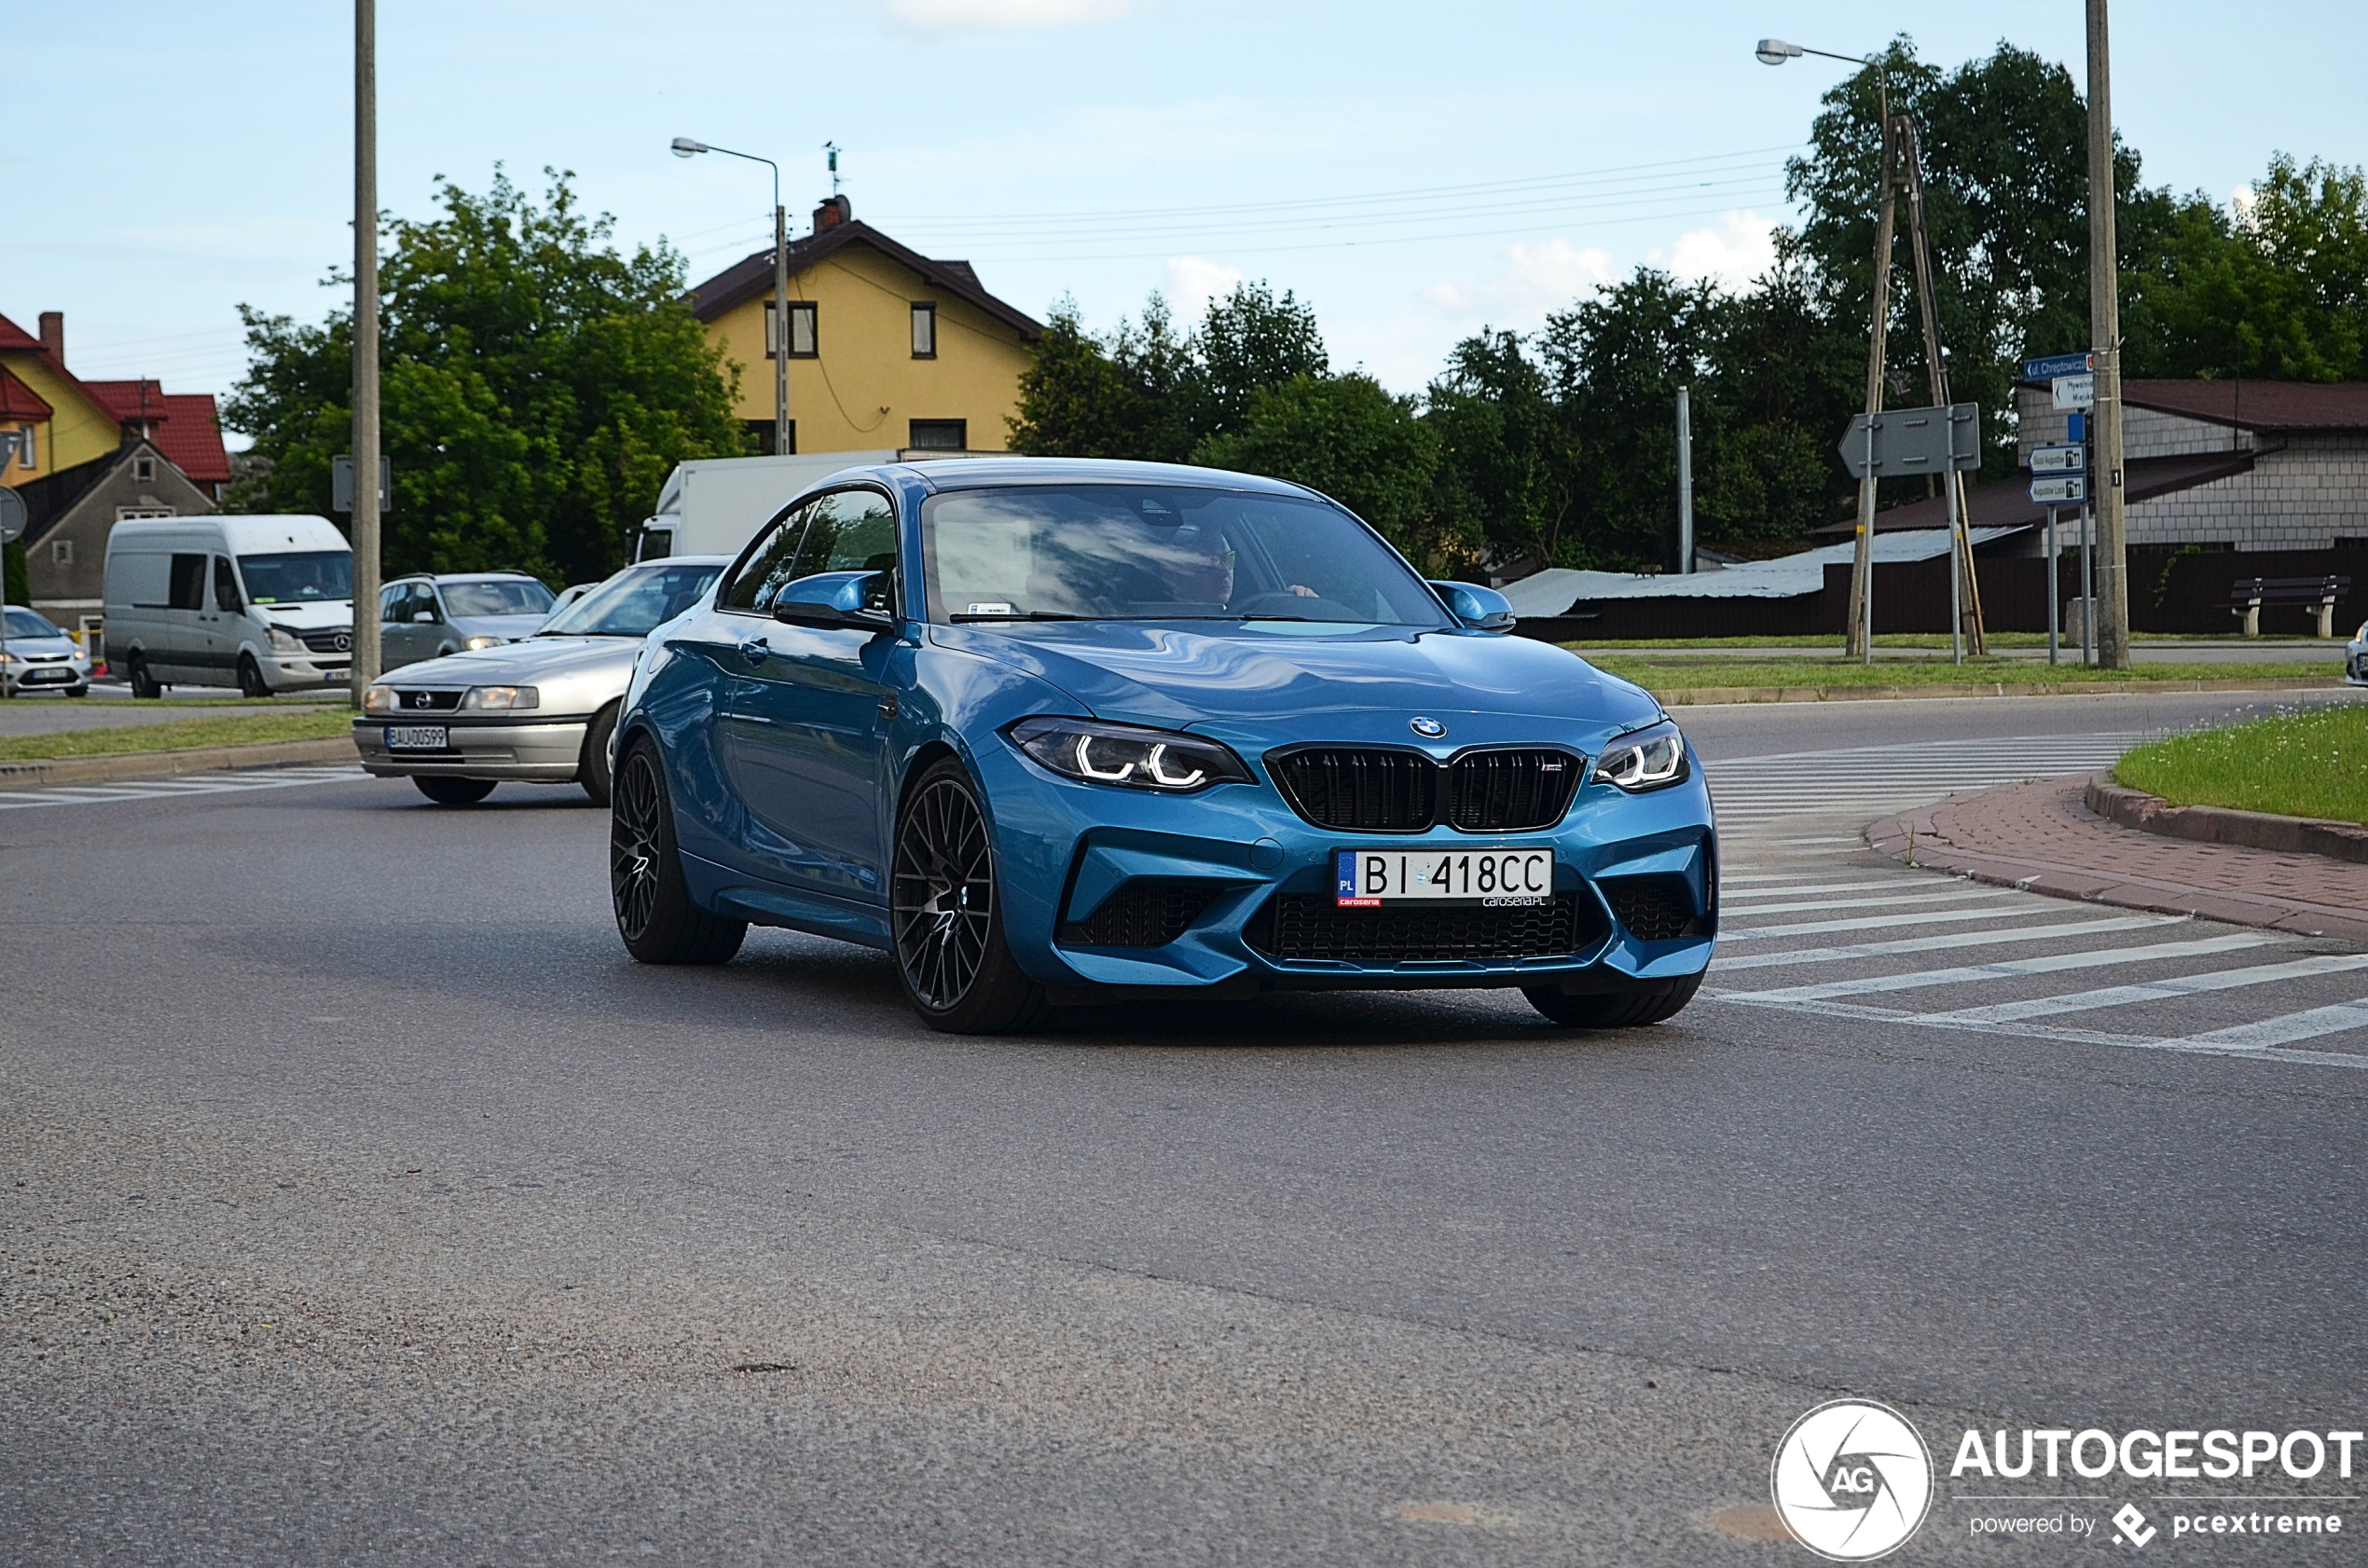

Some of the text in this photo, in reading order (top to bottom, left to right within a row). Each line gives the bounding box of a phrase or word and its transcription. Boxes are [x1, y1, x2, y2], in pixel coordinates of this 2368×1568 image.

[2042, 359, 2086, 375] Chreptowicza
[2114, 472, 2119, 485] 1
[1365, 855, 1545, 894] BI 418CC
[1340, 880, 1354, 891] PL
